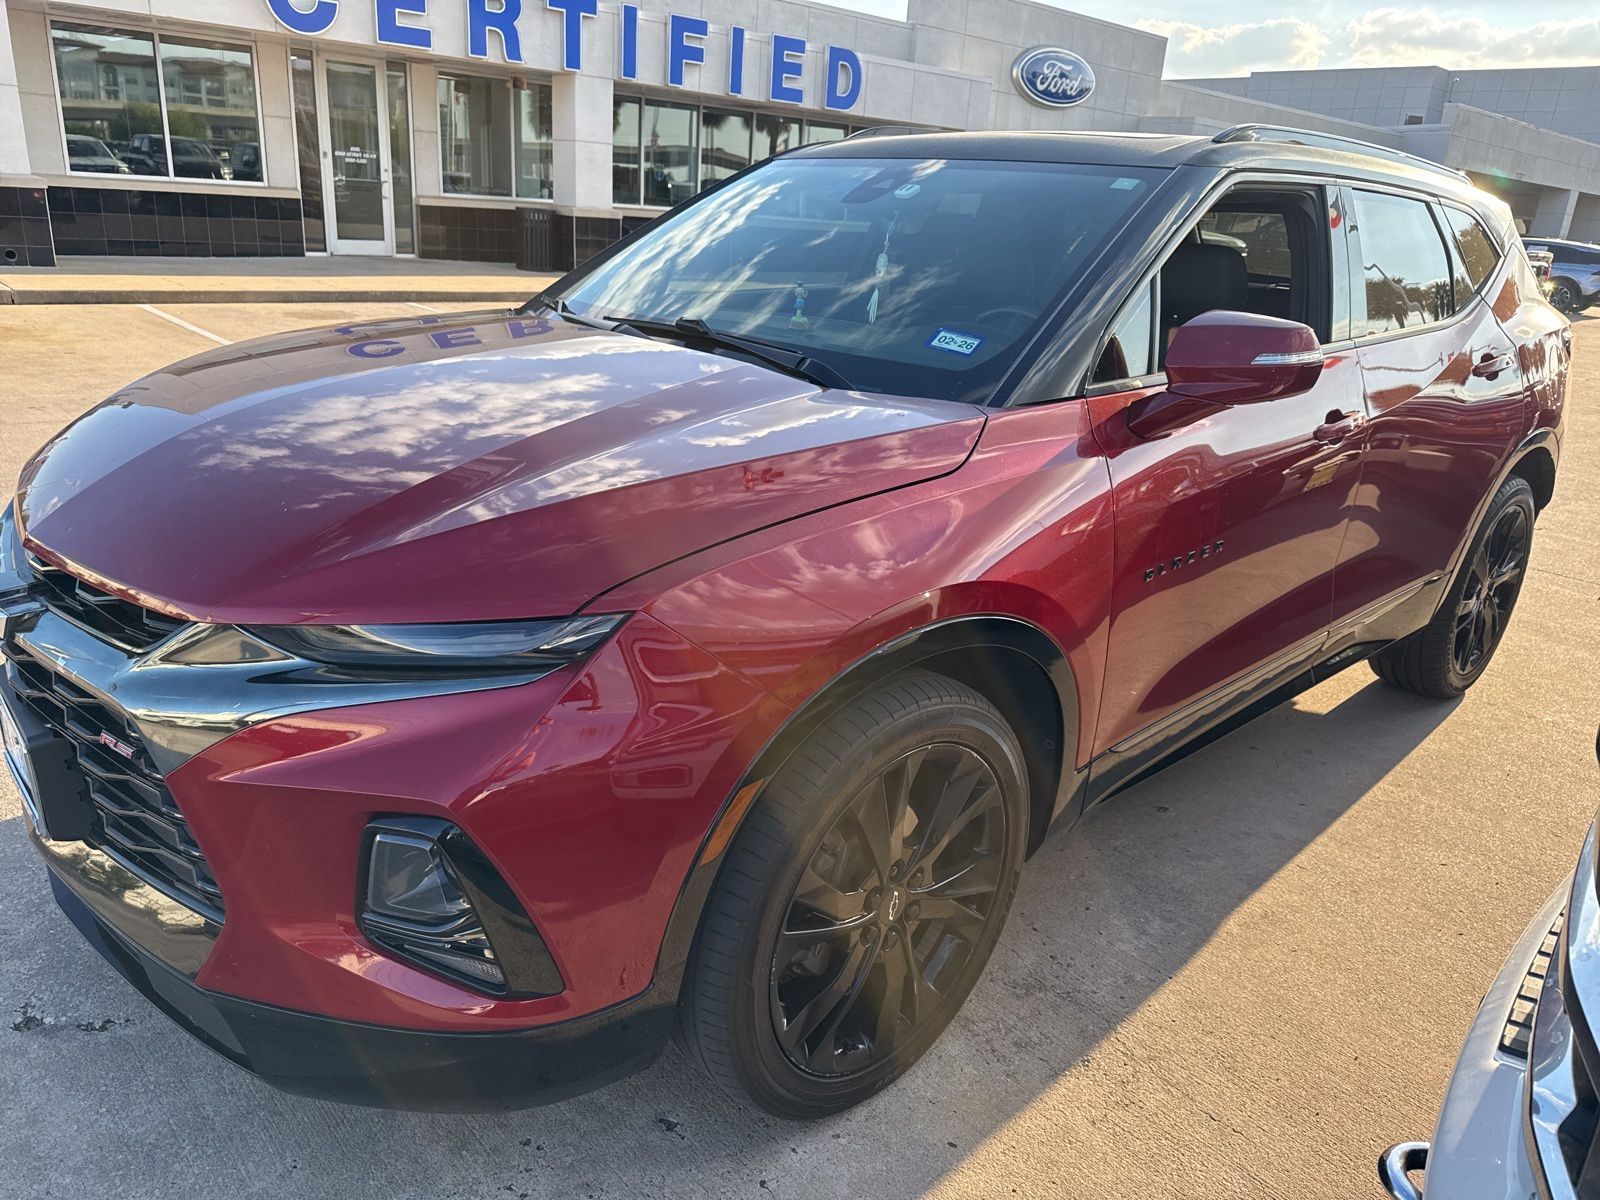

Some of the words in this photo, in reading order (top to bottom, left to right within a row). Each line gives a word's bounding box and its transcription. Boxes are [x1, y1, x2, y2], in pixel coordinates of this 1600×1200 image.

[1036, 60, 1083, 96] Ford
[1143, 540, 1225, 583] BLAZER
[99, 732, 134, 760] RS
